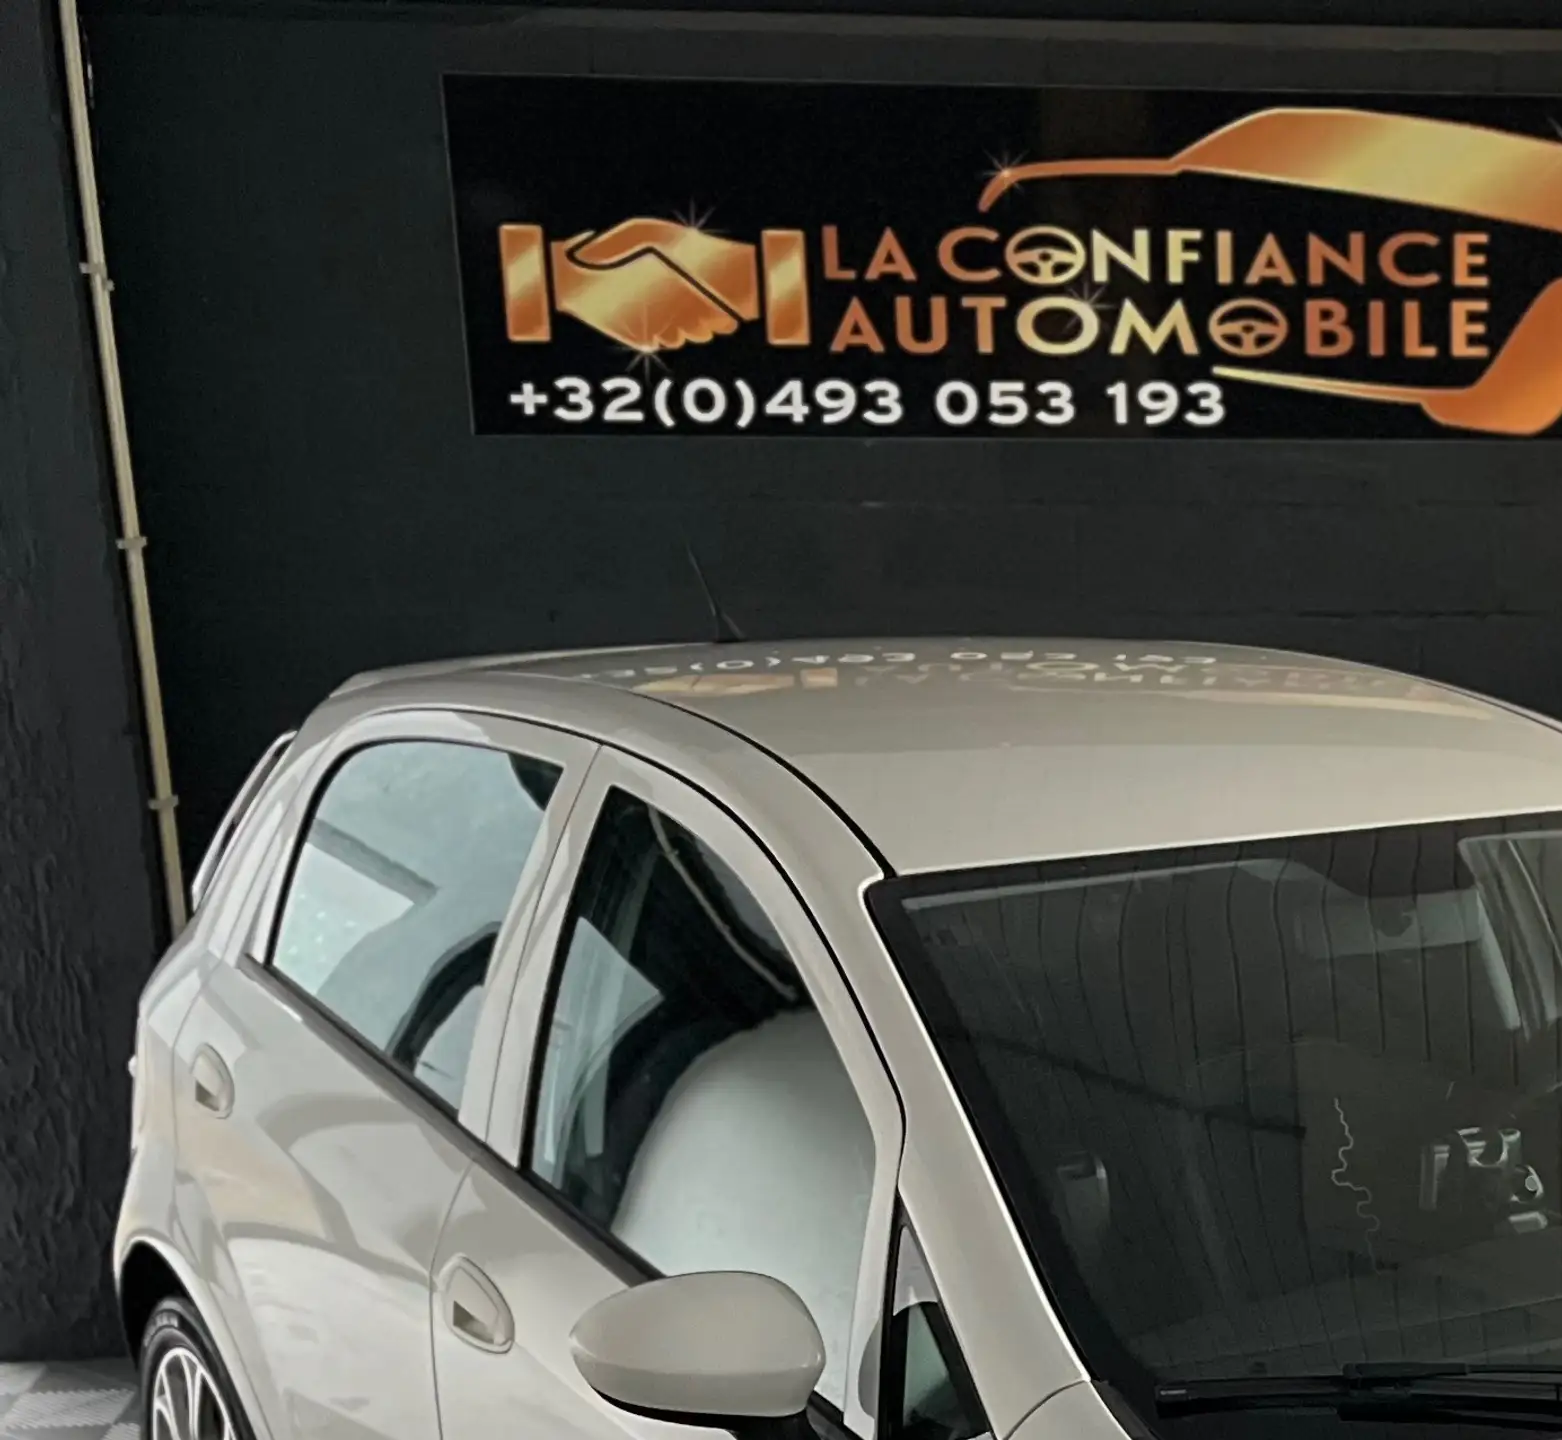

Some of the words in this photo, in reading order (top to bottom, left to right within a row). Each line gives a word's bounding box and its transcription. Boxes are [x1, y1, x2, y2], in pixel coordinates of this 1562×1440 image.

[823, 226, 916, 281] LA
[938, 226, 1489, 286] CONFIANCE
[831, 296, 1489, 357] AUTOMOBILE
[510, 376, 902, 427] +32(0)493
[935, 381, 1075, 425] 053
[1106, 381, 1225, 425] 193
